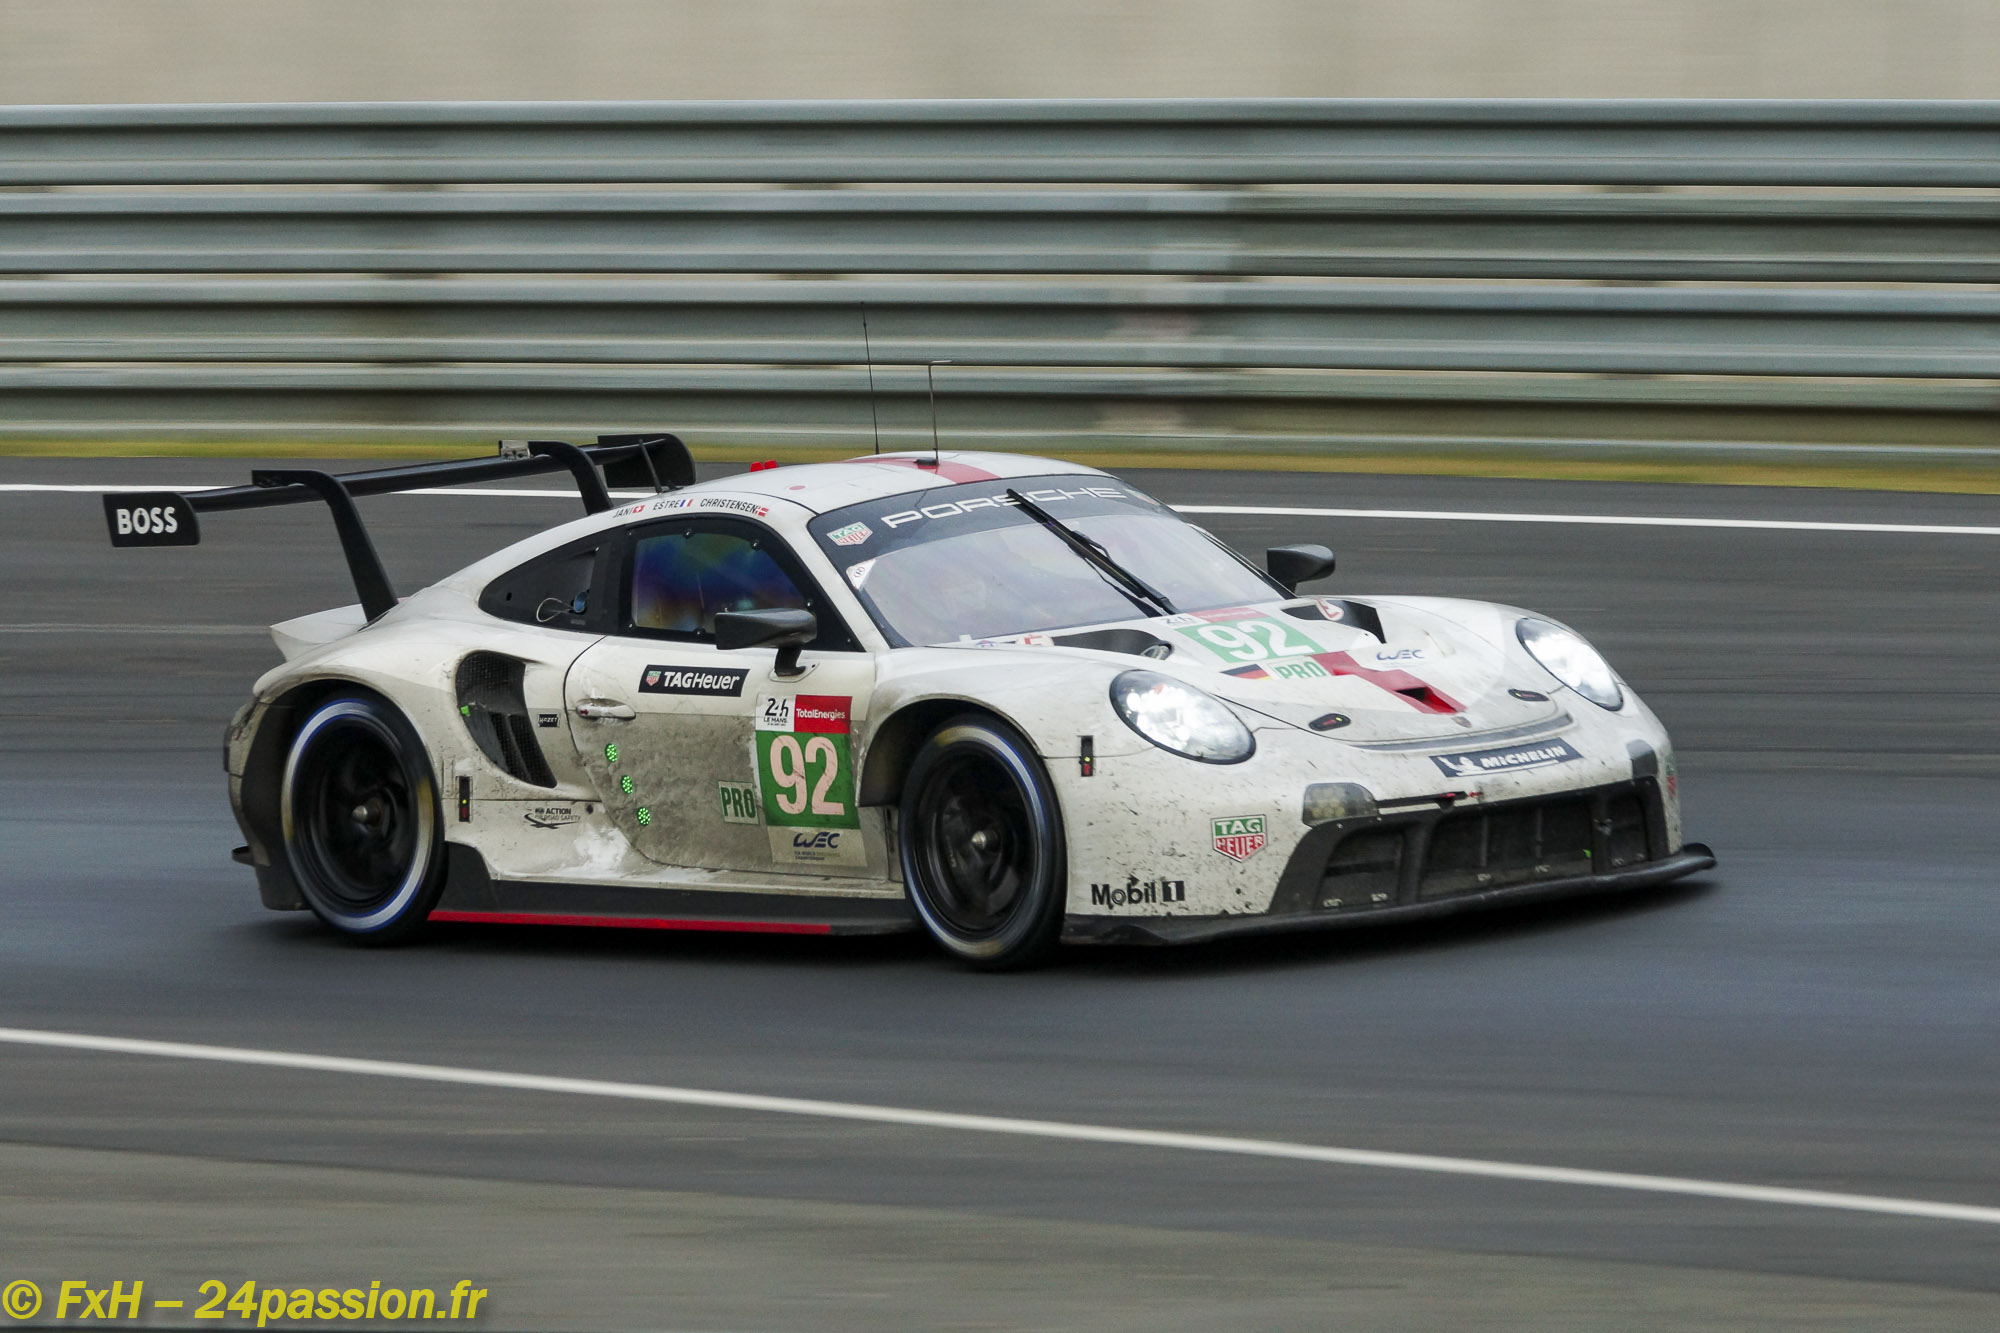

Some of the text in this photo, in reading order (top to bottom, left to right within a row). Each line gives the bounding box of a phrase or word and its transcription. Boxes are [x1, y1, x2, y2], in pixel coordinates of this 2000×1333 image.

[613, 498, 758, 518] JANI ESTRE CHRISTENSEN
[881, 487, 1128, 529] PORSCHE
[116, 506, 178, 535] BOSS
[1196, 620, 1316, 660] 92
[1376, 649, 1425, 661] WEC
[1275, 661, 1328, 679] PRO
[795, 708, 846, 721] TotalEnergies
[1480, 746, 1568, 768] MICHELIN
[770, 734, 845, 816] 92
[720, 786, 757, 819] PRO
[1215, 819, 1262, 836] TAG
[792, 831, 841, 849] WEC
[1216, 836, 1264, 858] HEUER
[1091, 882, 1156, 905] Mobil
